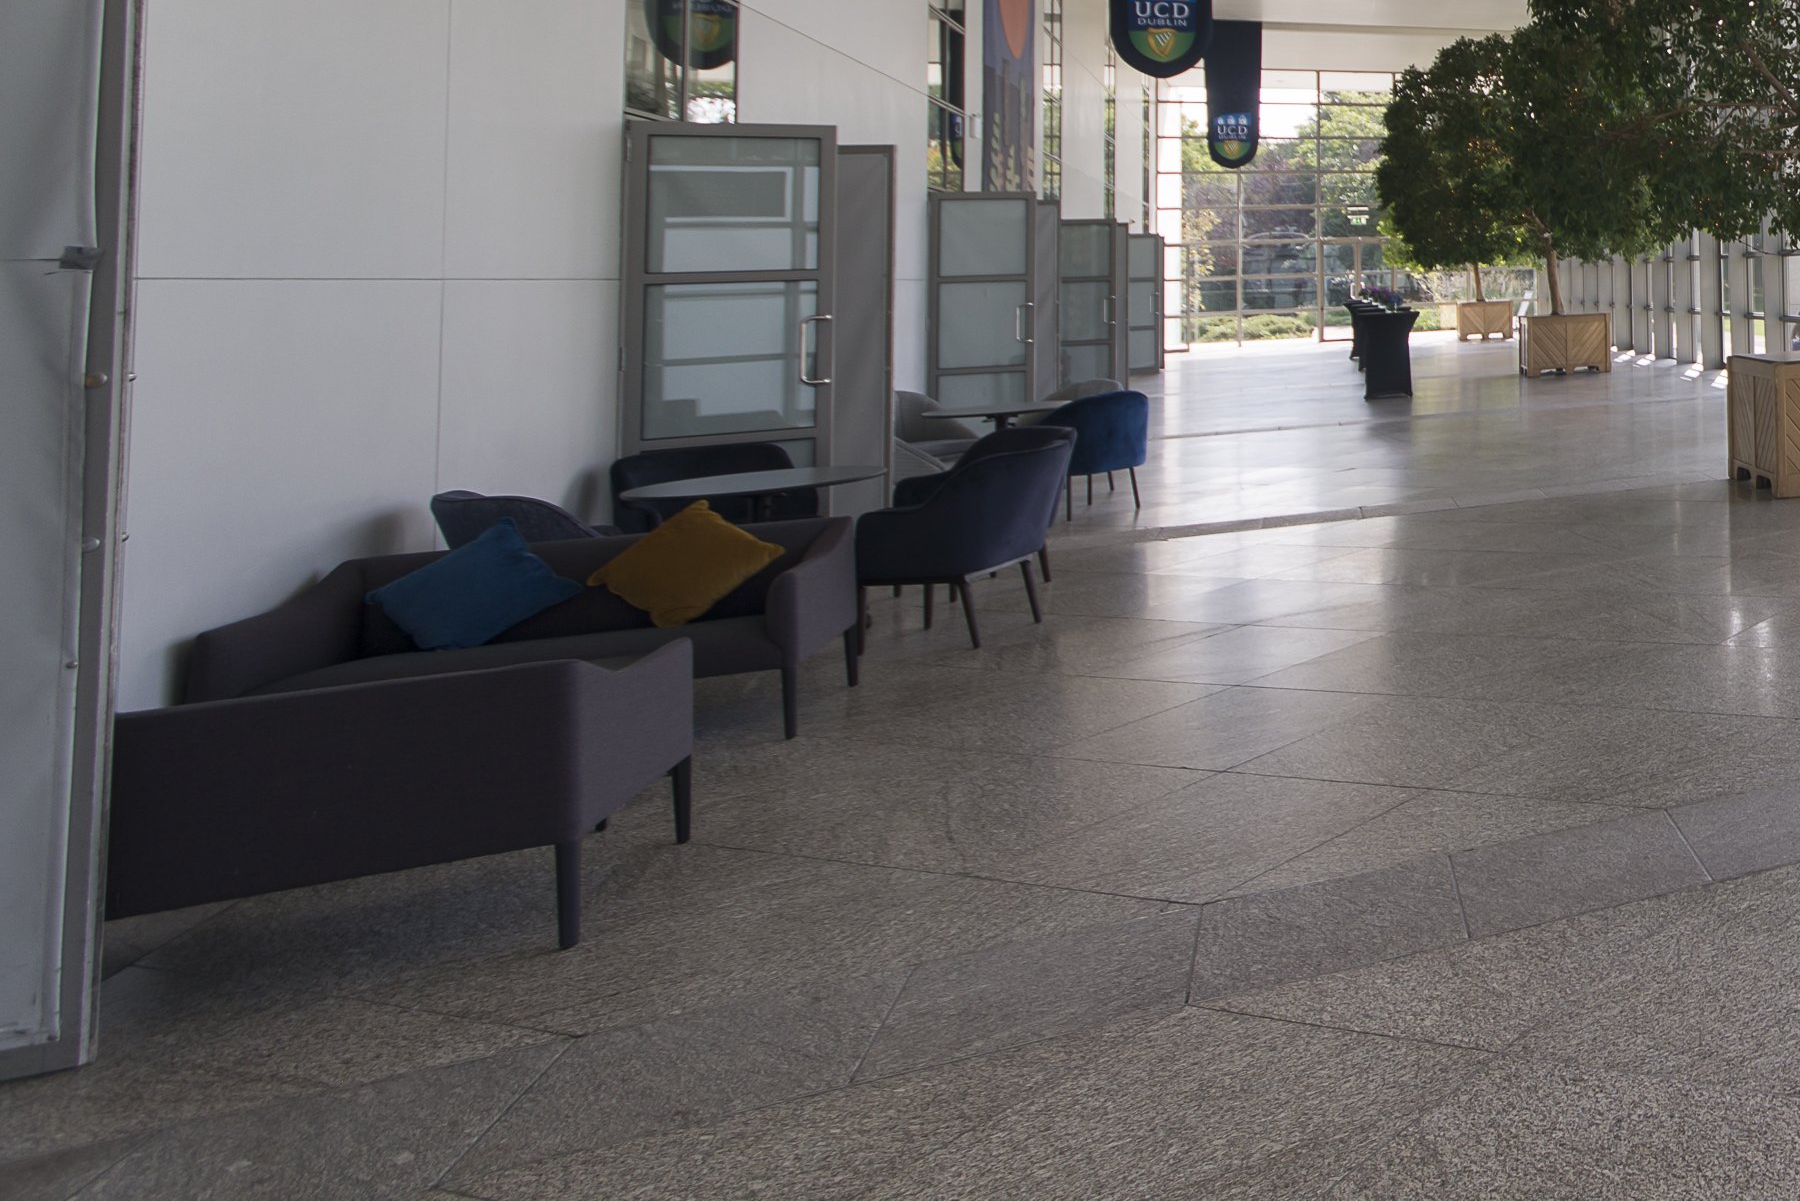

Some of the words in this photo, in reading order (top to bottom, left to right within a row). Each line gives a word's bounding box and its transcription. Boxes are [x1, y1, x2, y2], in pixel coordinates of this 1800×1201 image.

[1135, 1, 1189, 18] UCD
[1137, 18, 1187, 26] DUBLIN
[1217, 125, 1247, 135] UCD
